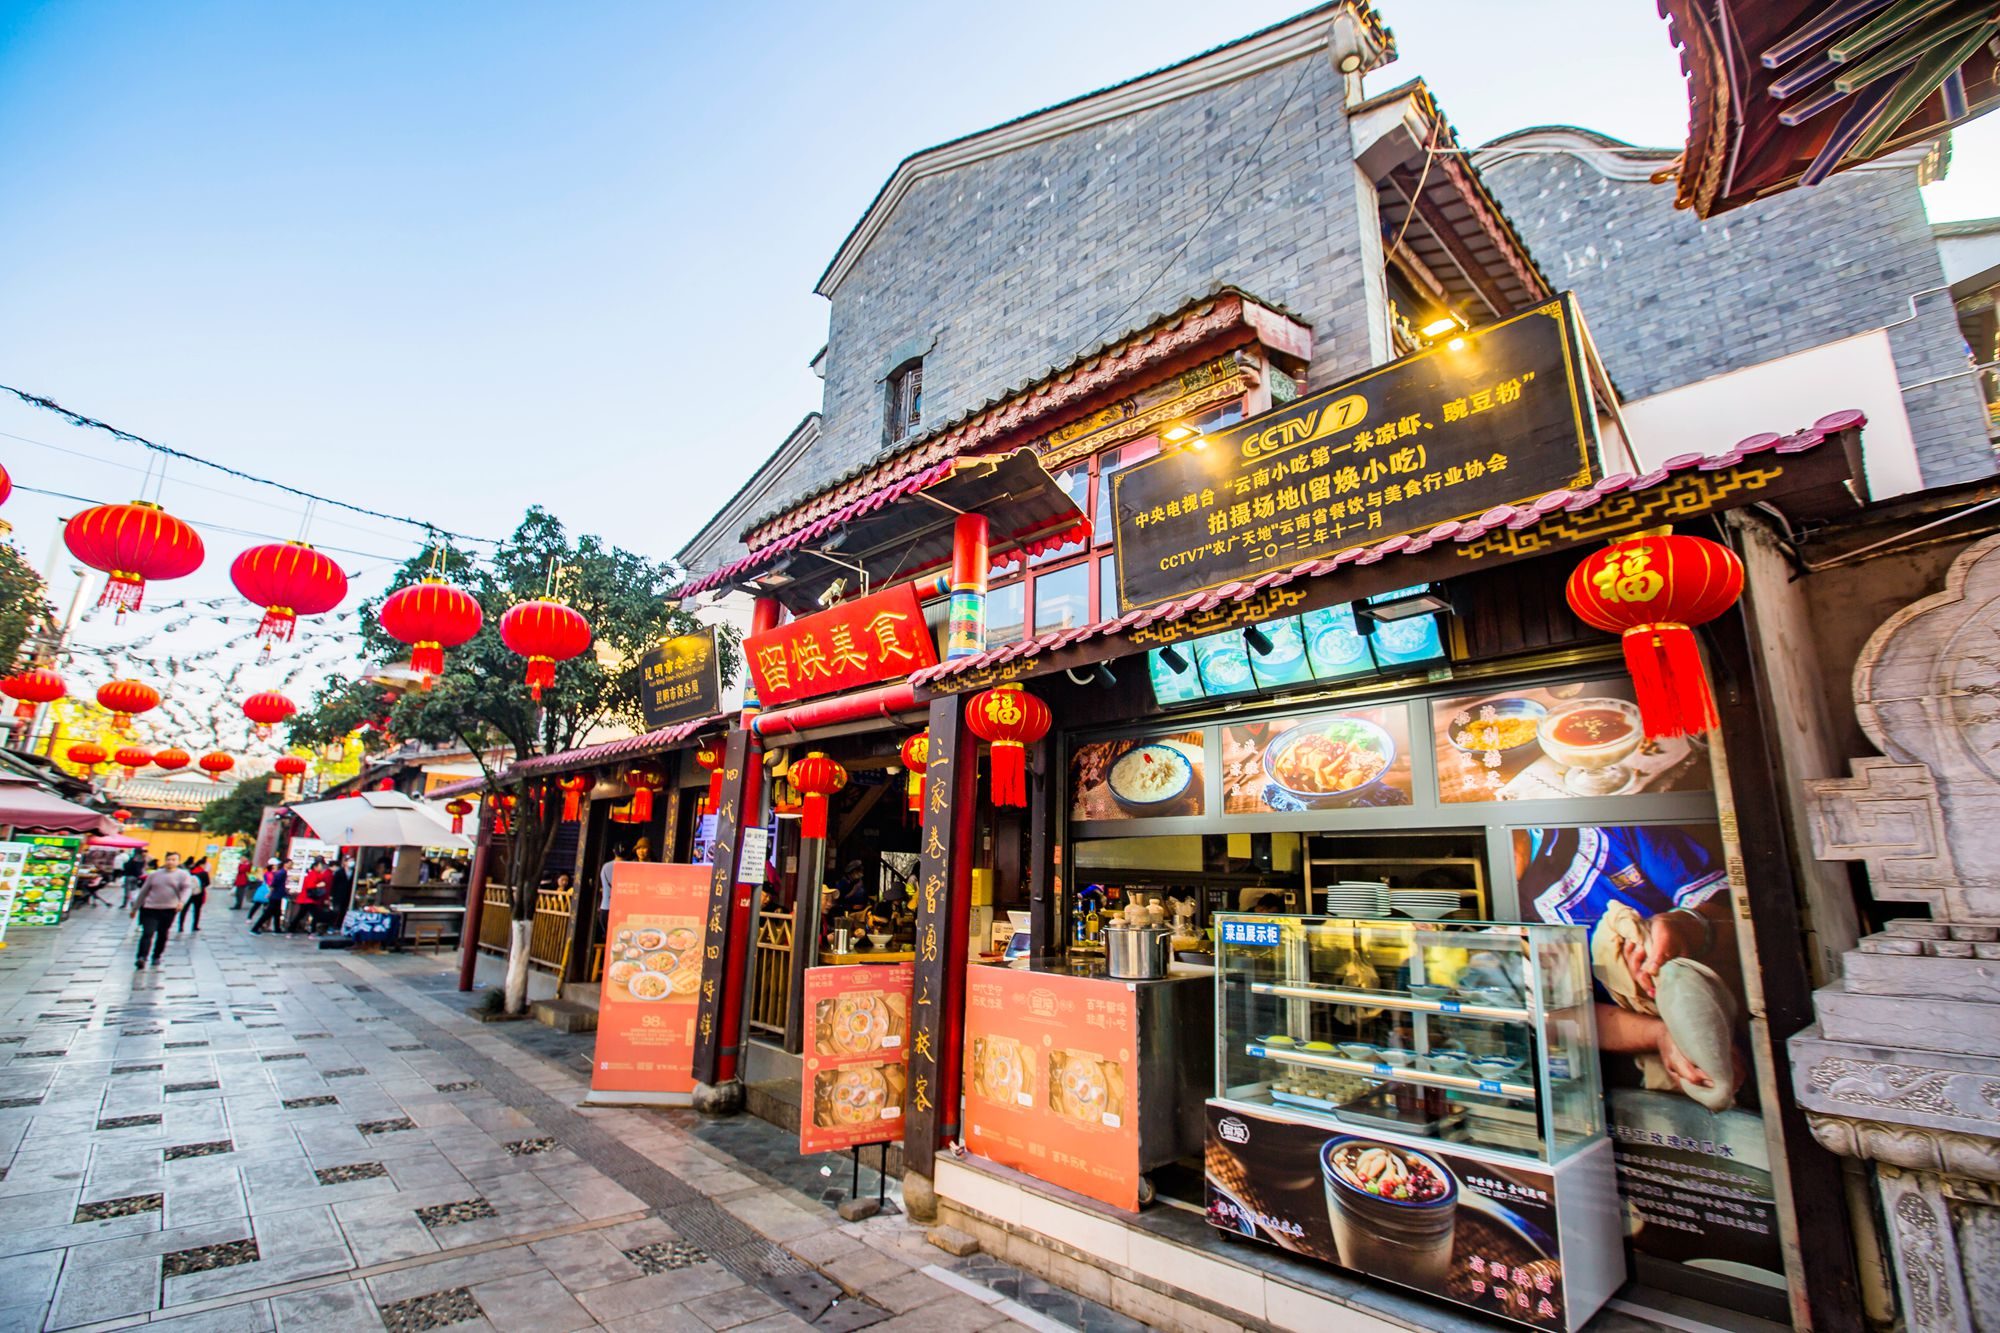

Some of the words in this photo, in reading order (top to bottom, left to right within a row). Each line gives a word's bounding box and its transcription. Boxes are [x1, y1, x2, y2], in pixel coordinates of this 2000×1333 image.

[1241, 409, 1319, 457] CCTV
[1593, 546, 1664, 603] 福
[757, 611, 914, 692] 留焕美食
[985, 692, 1022, 726] 福
[1225, 923, 1278, 944] 菜品展示柜
